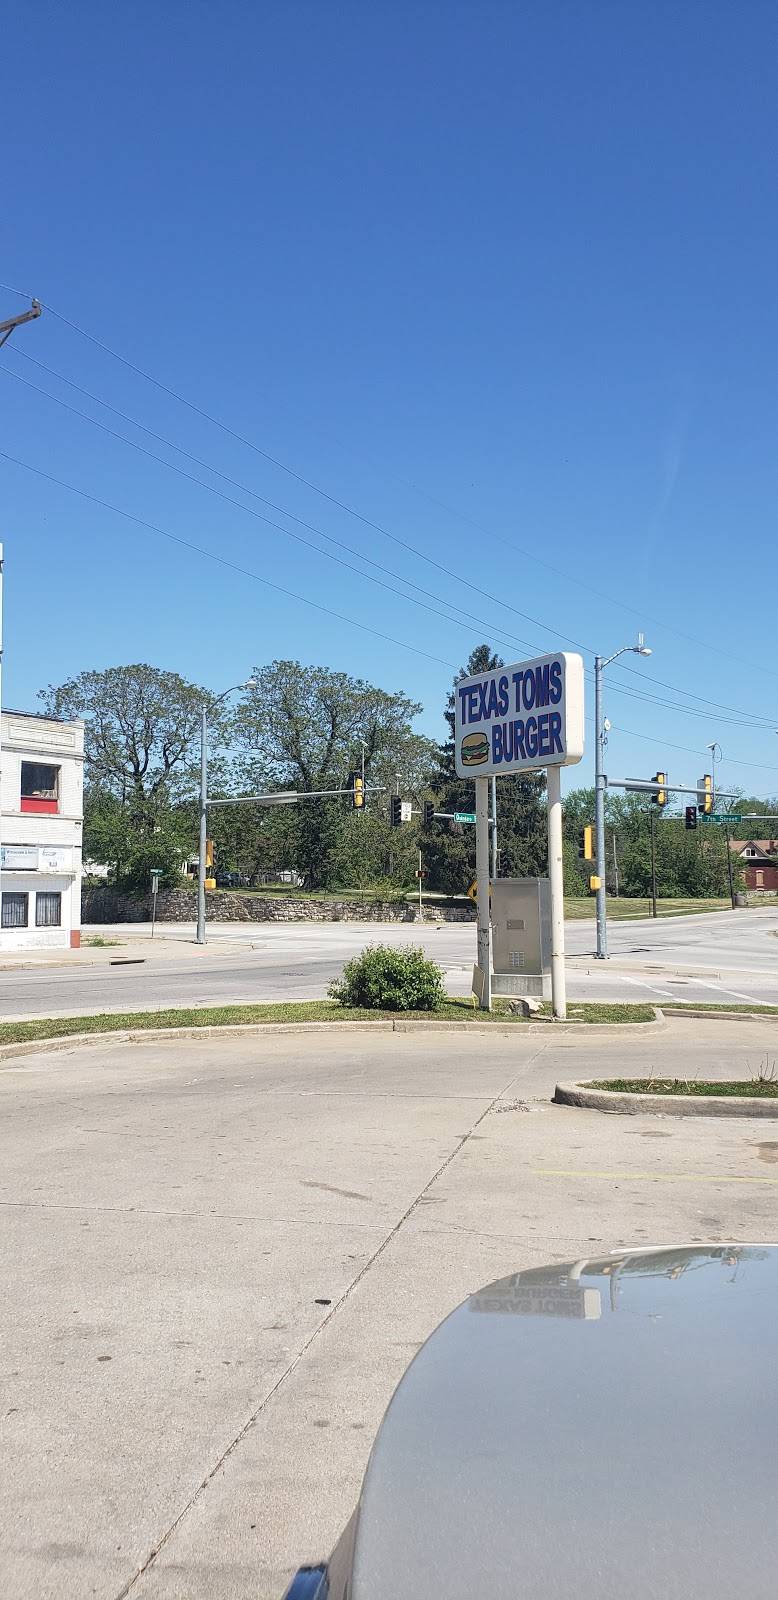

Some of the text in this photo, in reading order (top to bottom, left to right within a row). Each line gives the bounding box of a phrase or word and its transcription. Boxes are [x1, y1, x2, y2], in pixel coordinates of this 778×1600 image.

[458, 661, 563, 726] TEXAS TOMS
[491, 711, 565, 765] BURGER
